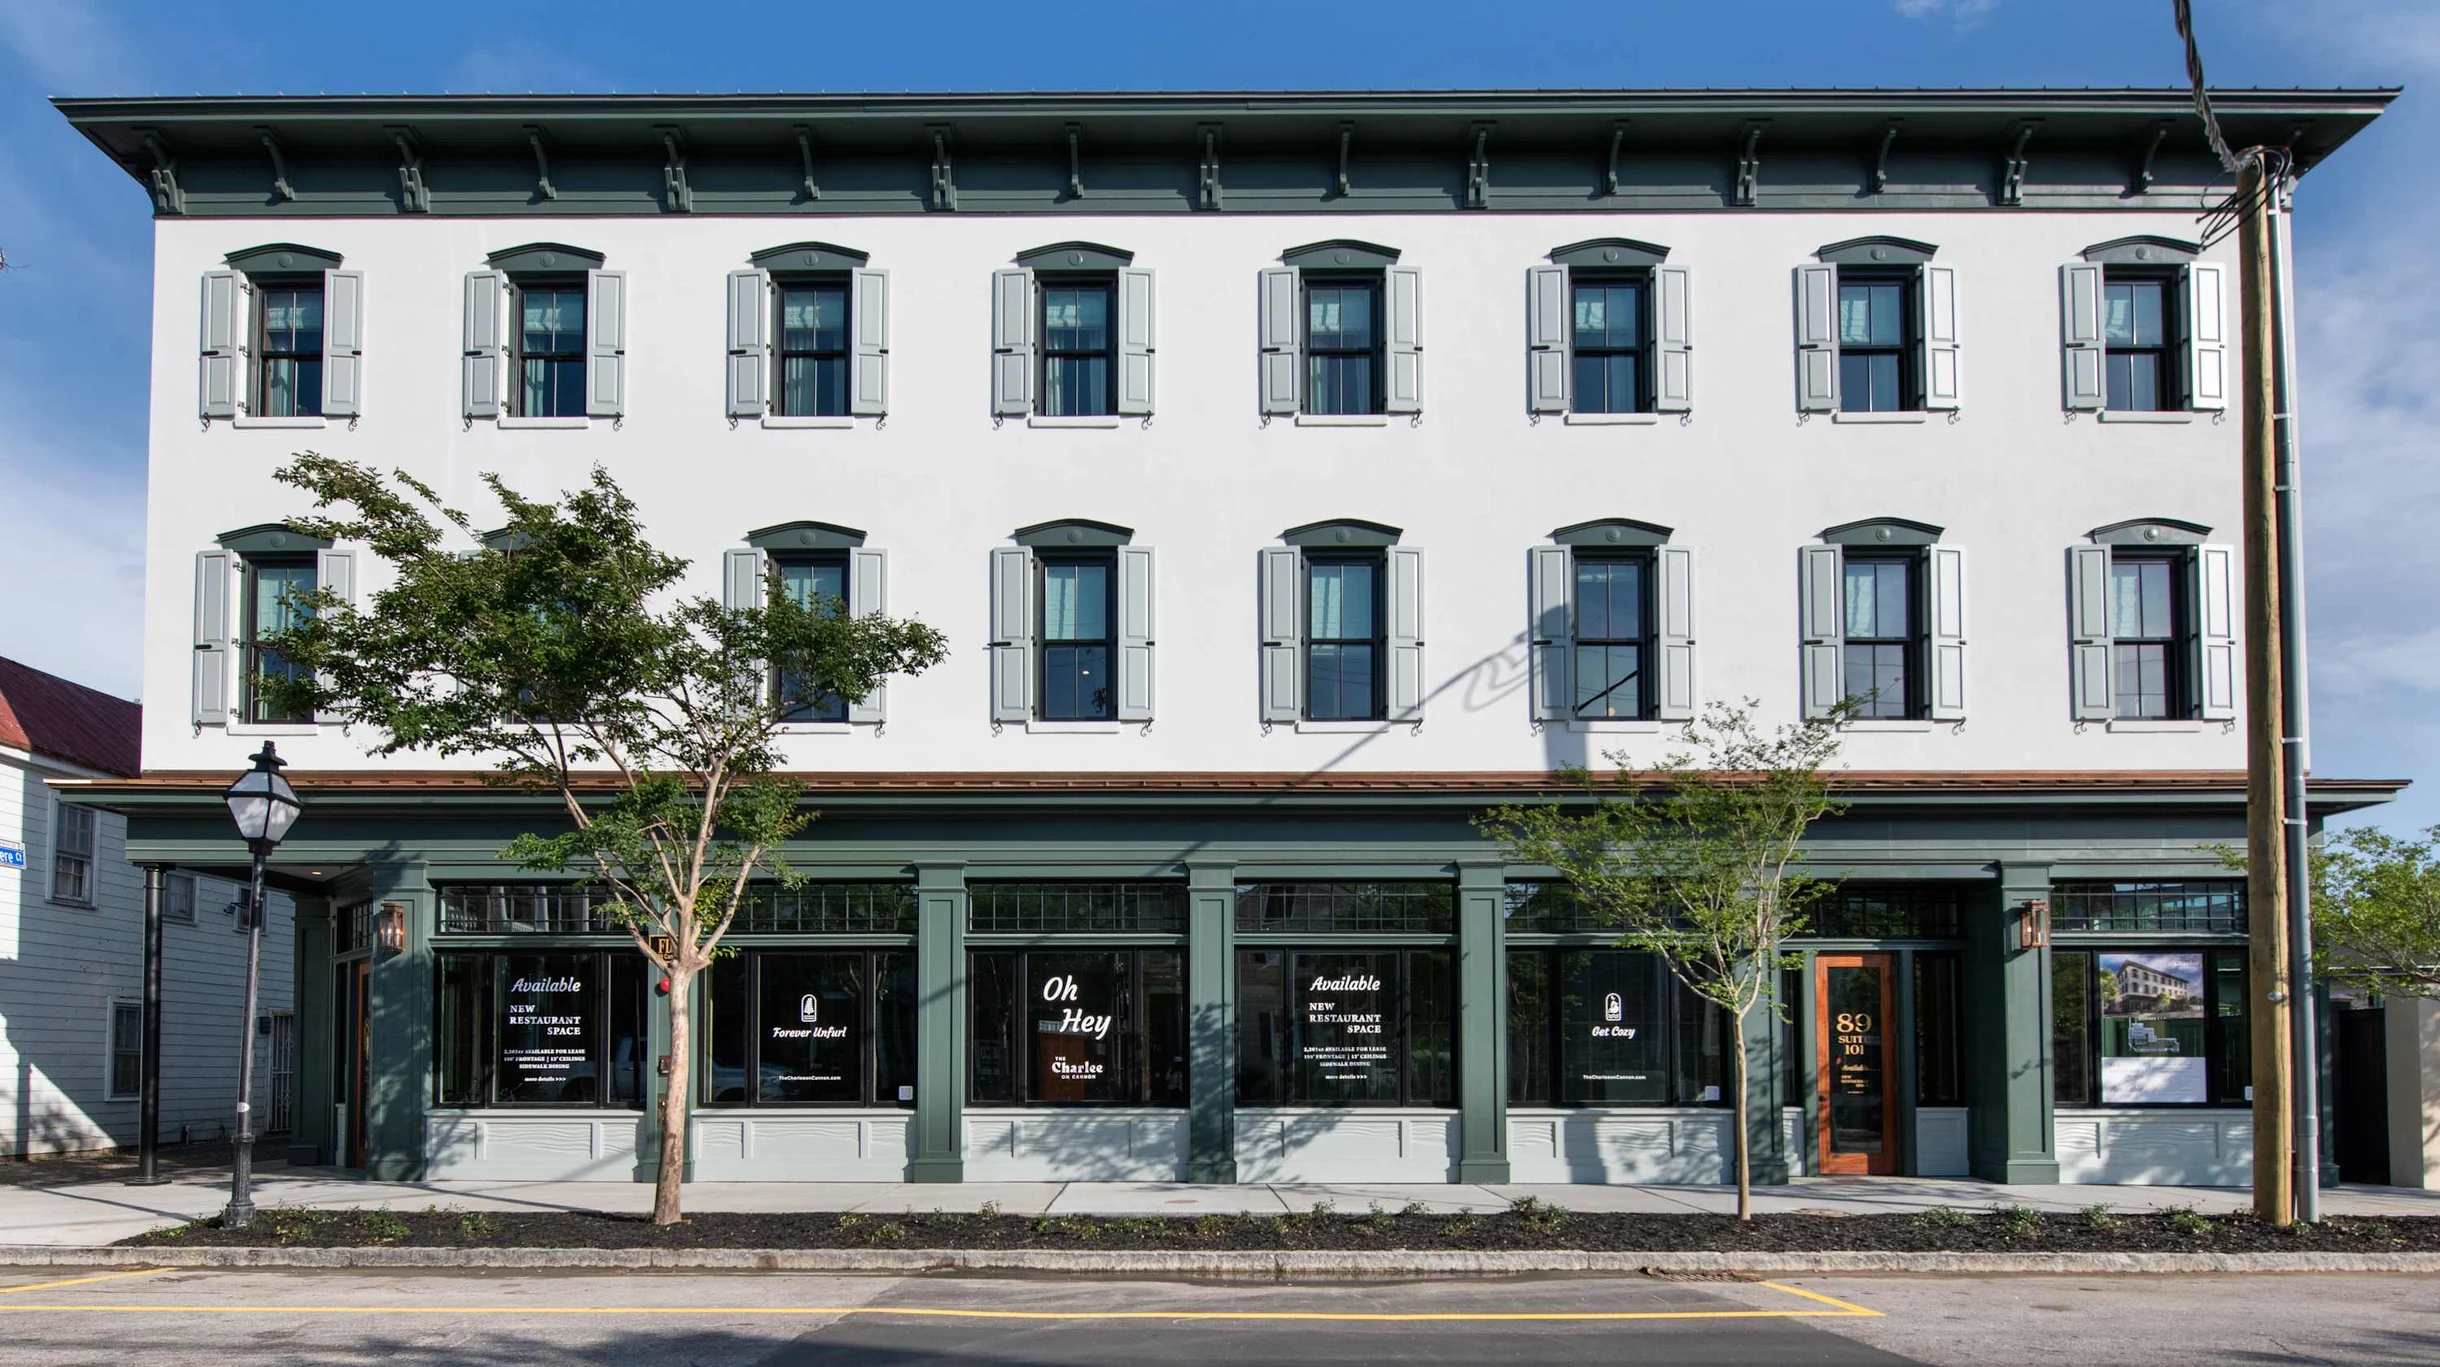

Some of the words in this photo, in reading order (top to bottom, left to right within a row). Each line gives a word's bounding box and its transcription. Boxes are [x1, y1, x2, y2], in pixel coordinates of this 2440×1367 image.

[511, 977, 581, 992] Available
[1044, 975, 1077, 1001] Oh
[1310, 975, 1380, 990] Available
[509, 1004, 536, 1013] NEW
[1308, 1002, 1336, 1011] NEW
[509, 1016, 582, 1025] RESTAURANT
[1309, 1014, 1382, 1023] RESTAURANT
[1837, 1013, 1871, 1032] 89
[1058, 1009, 1111, 1040] Hey
[1347, 1024, 1382, 1034] SPACE
[546, 1026, 581, 1036] SPACE
[772, 1027, 812, 1038] Forever
[813, 1027, 846, 1038] Unfurl
[1591, 1025, 1611, 1037] Get
[1611, 1026, 1635, 1039] Cozy
[1844, 1044, 1864, 1055] 101
[1051, 1060, 1103, 1073] Charlee
